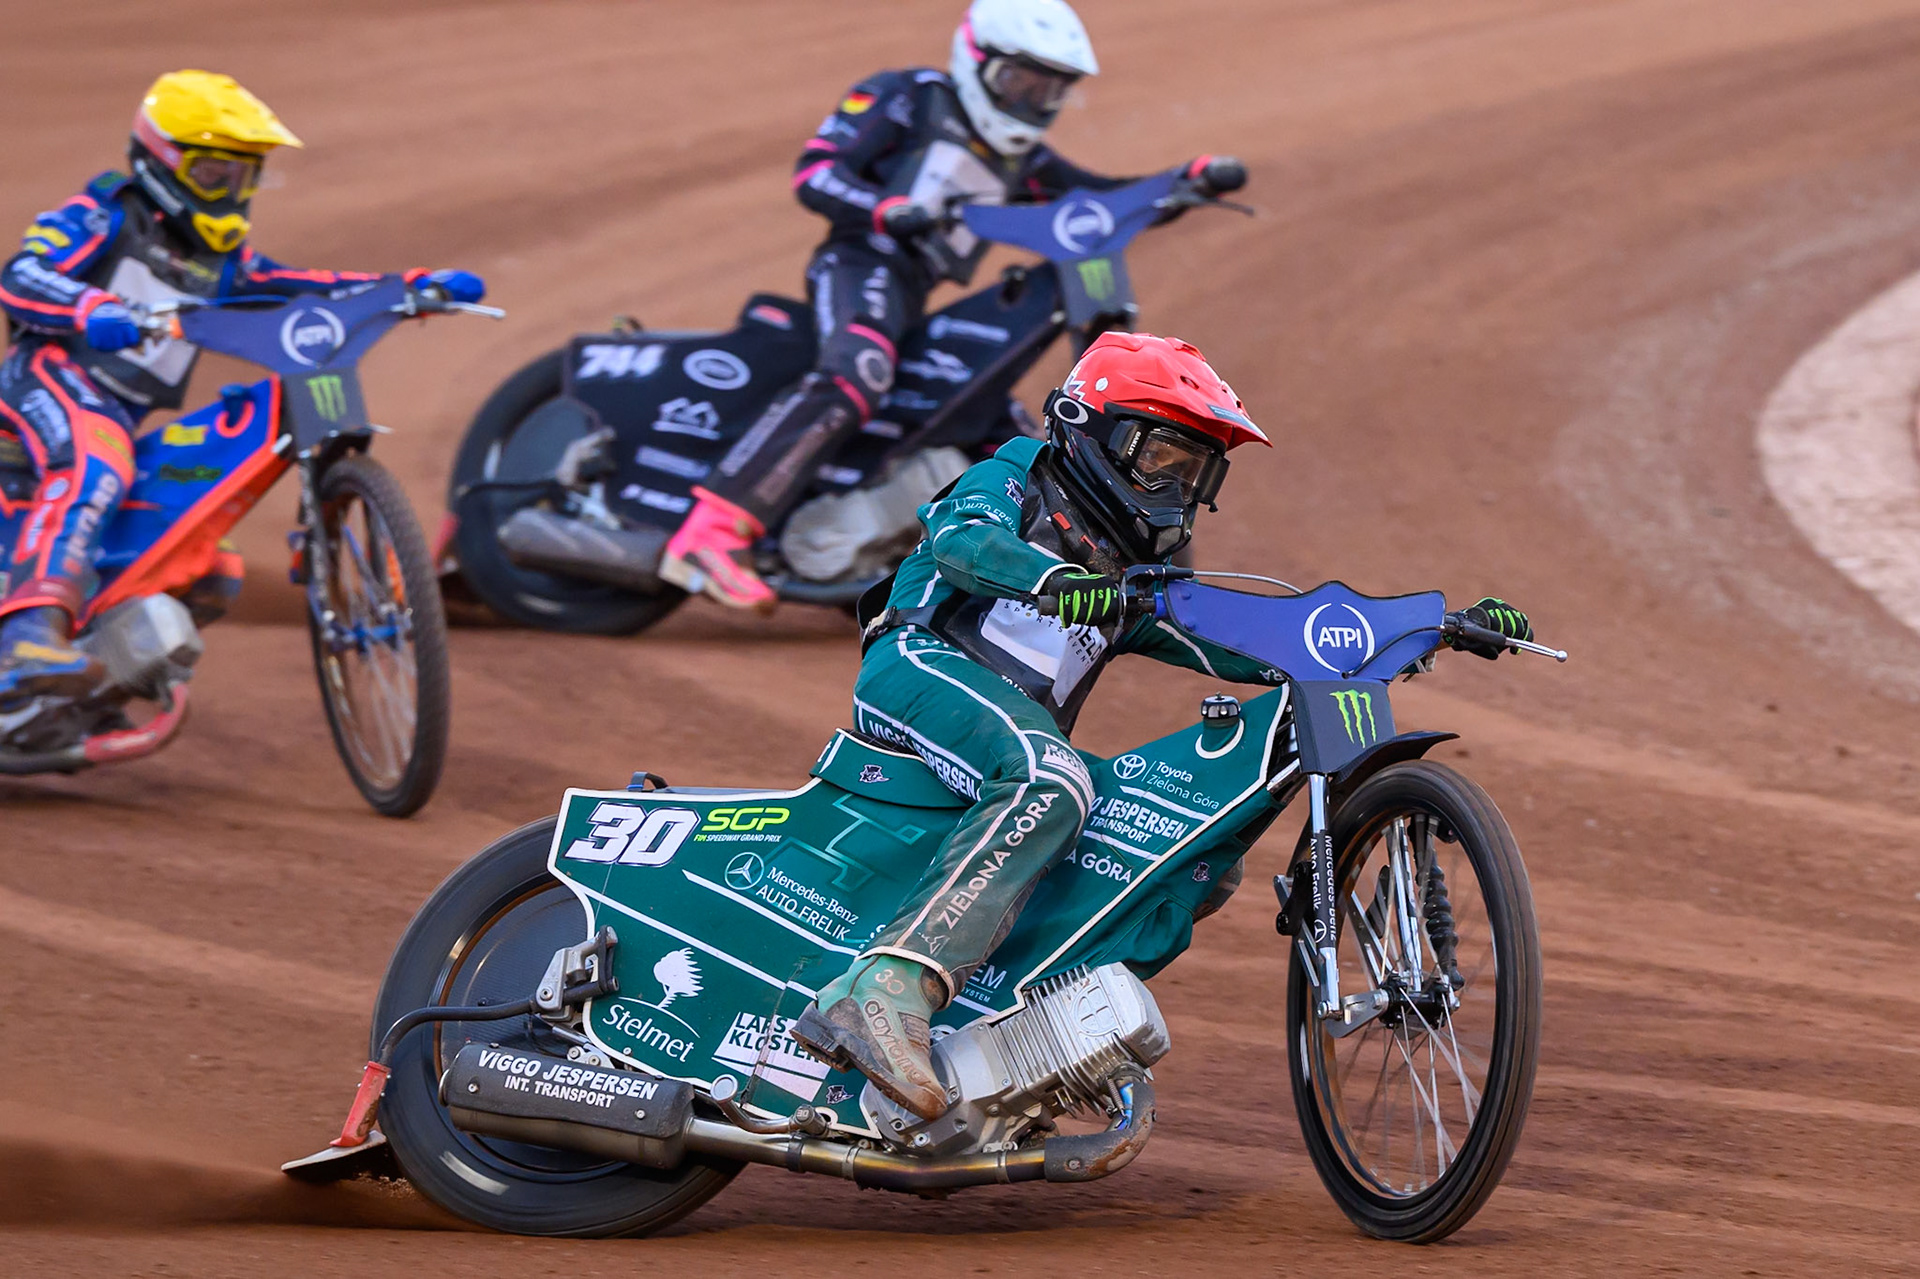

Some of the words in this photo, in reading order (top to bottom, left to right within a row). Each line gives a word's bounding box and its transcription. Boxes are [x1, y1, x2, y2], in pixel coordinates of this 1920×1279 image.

[1127, 431, 1141, 457] OAKLEY
[1317, 626, 1362, 649] ATPI
[1156, 761, 1193, 783] Toyota
[1146, 774, 1190, 799] Zielona
[1192, 792, 1220, 810] Góra
[563, 801, 701, 868] 30
[701, 807, 790, 831] SGP
[1090, 816, 1152, 844] TRANSPORT
[1101, 797, 1189, 840] JESPERSEN
[694, 834, 707, 842] FIM
[706, 834, 741, 842] SPEEDWAY
[740, 834, 764, 842] GRAND
[765, 835, 782, 843] PRIX
[938, 850, 1012, 930] ZIELONA
[1004, 792, 1060, 847] GÓRA
[1081, 852, 1133, 884] GÓRA
[766, 866, 860, 925] Mercedes-Benz
[1325, 835, 1337, 941] Mercedes-Benz
[755, 884, 798, 913] AUTO
[798, 906, 851, 941] FRELIK
[874, 969, 905, 995] 30
[602, 1003, 695, 1063] Stelmet
[478, 1050, 542, 1078] VIGGO
[543, 1064, 660, 1100] JESPERSEN
[504, 1075, 530, 1093] INT.
[535, 1080, 616, 1109] TRANSPORT
